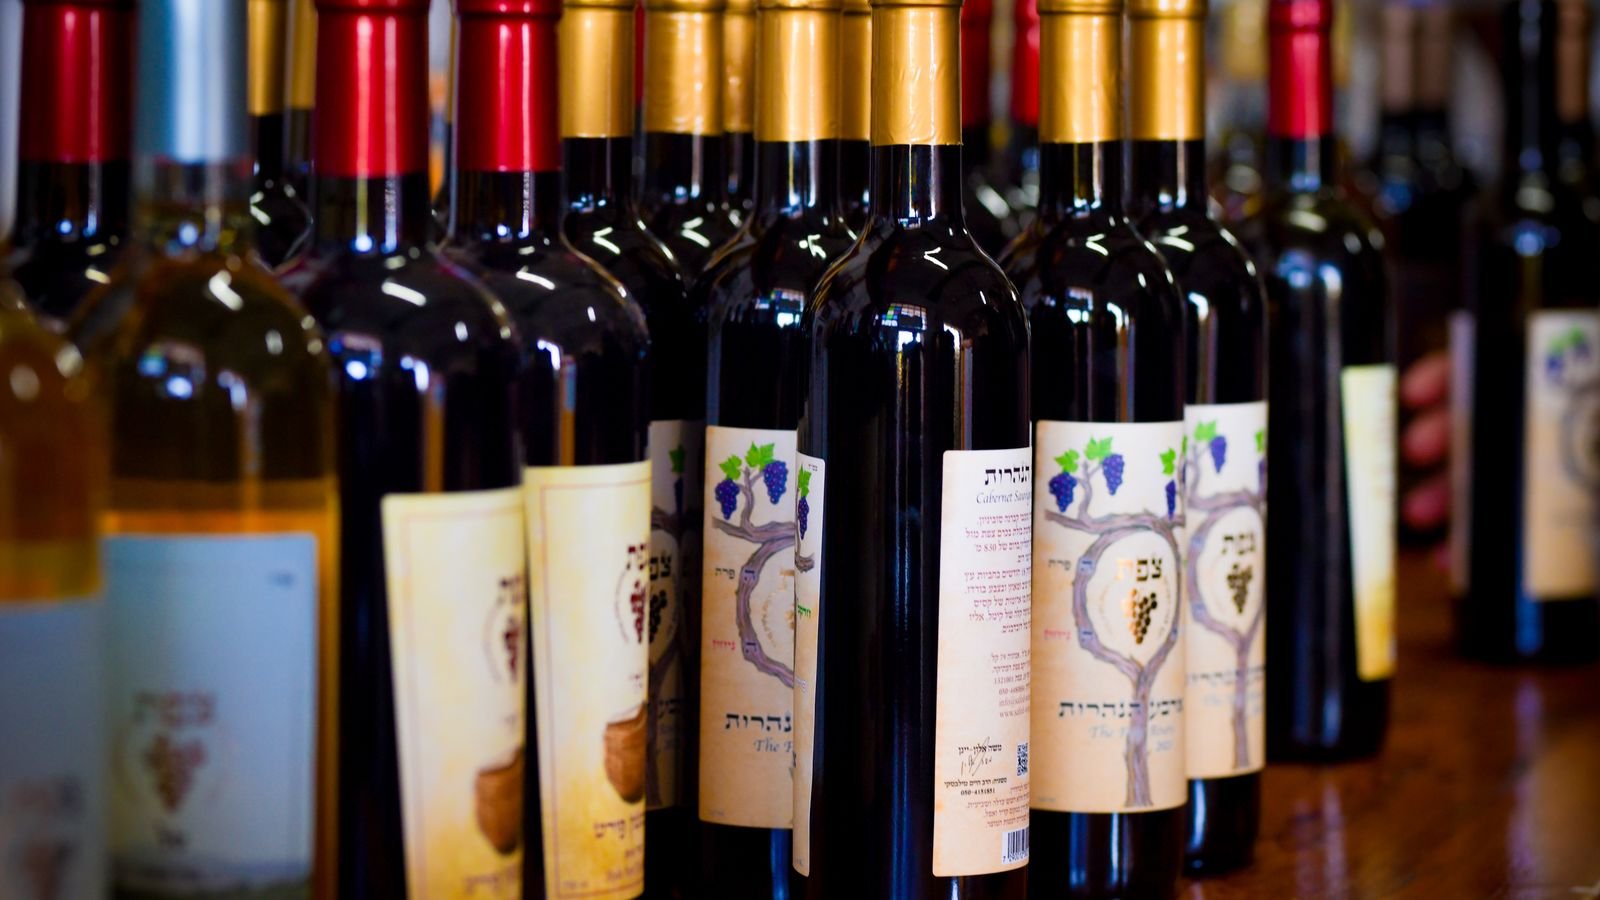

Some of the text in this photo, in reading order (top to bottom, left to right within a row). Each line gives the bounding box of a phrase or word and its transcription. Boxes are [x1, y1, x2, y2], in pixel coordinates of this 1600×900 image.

[976, 489, 1012, 504] Cabernet
[650, 550, 671, 581] צפ
[1116, 556, 1162, 582] צפת
[1059, 701, 1143, 719] הנהרות
[725, 709, 792, 733] נהרות
[754, 736, 780, 753] The
